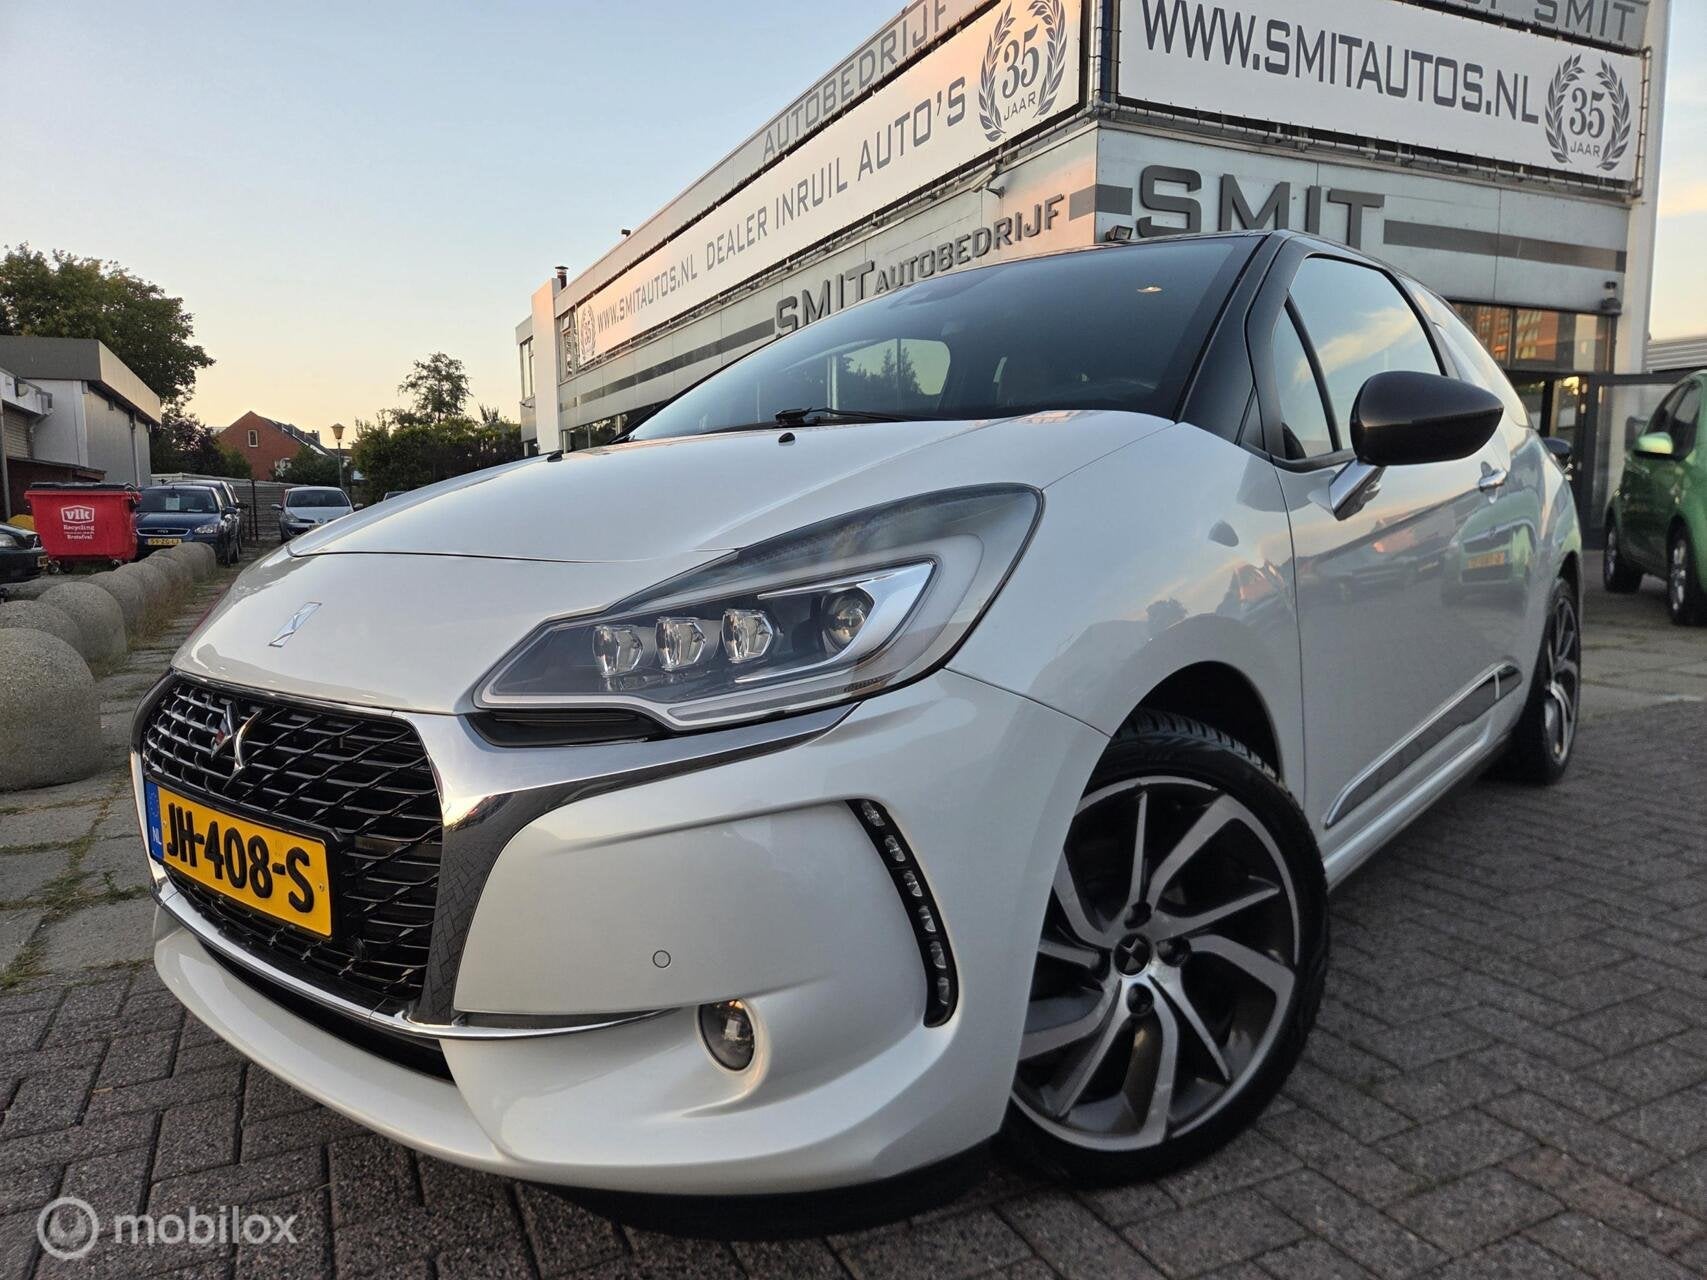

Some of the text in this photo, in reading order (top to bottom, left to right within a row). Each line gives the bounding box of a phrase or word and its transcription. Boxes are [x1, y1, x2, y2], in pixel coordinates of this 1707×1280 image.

[1534, 0, 1636, 41] SMIT
[762, 0, 946, 161] AUTOBEDRIJF
[1002, 24, 1039, 99] 35
[1142, 0, 1539, 124] WWW.SMITAUTOS.NL
[1003, 91, 1036, 121] JAAR
[1569, 87, 1605, 139] 35
[1570, 141, 1600, 157] JAAR
[597, 76, 966, 333] WWW.SMITAUTOS.NL DEALER INRUIL AUTO'S
[1136, 165, 1386, 250] SMIT
[775, 194, 1065, 338] SMIT AUTOBEDRIJF
[152, 825, 162, 845] NL
[167, 802, 315, 914] JH-408-S
